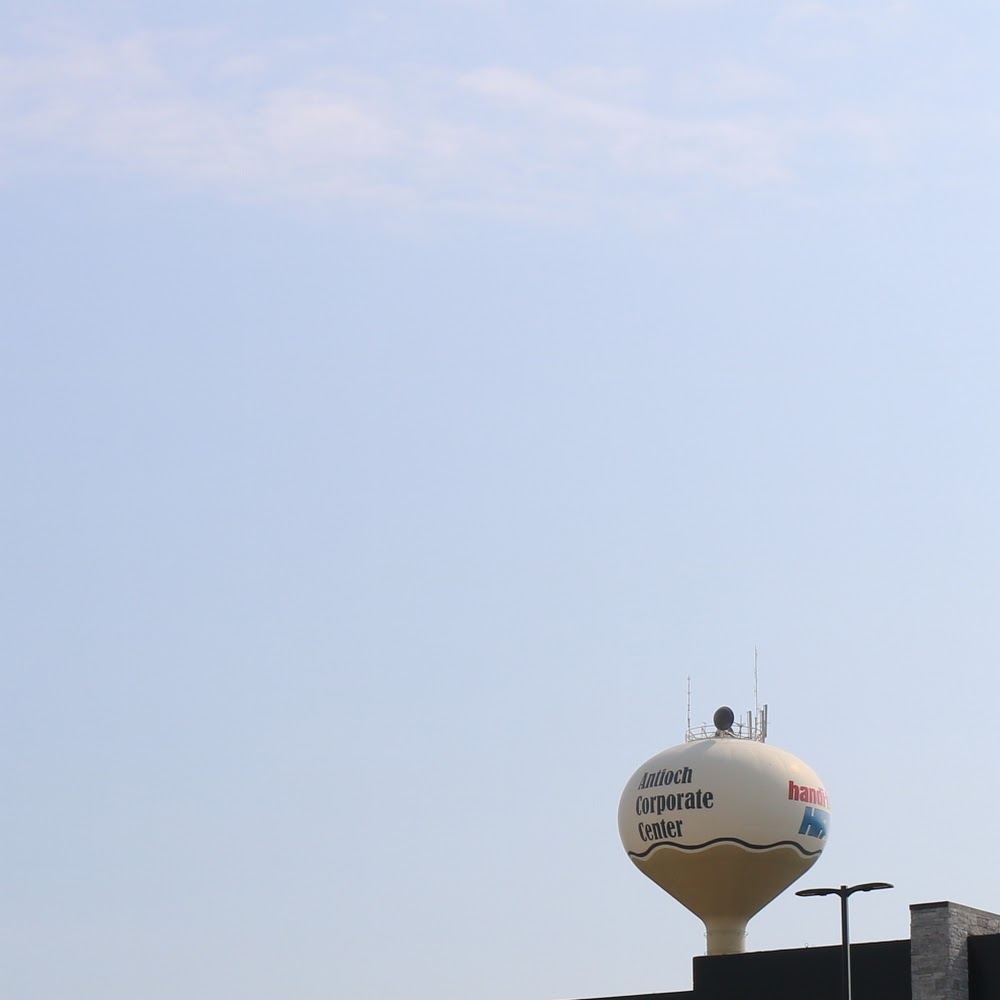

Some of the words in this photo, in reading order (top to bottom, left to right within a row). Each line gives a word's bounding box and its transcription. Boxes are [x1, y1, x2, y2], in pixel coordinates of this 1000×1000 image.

[638, 766, 693, 790] Antioch
[635, 788, 714, 816] Corporate
[638, 818, 684, 842] Center
